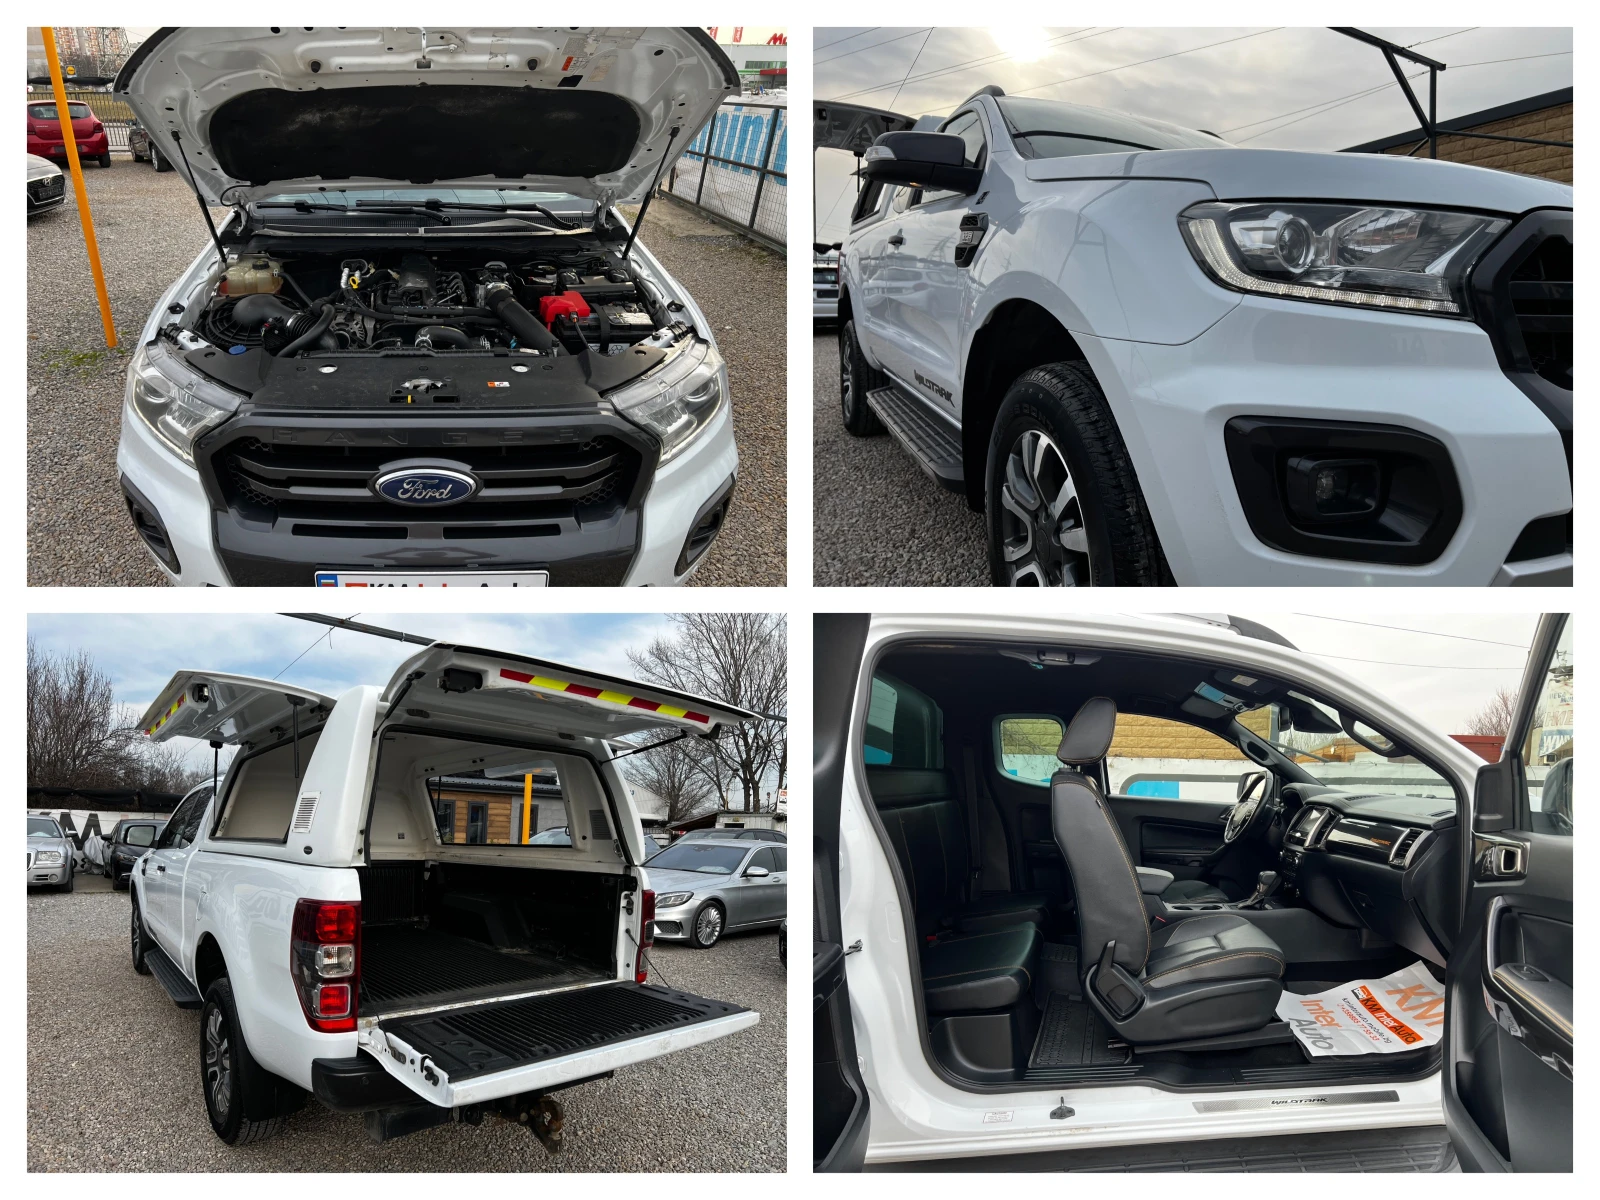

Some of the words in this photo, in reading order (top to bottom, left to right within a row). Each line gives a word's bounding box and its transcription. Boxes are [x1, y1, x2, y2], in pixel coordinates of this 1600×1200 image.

[272, 428, 580, 445] RANGER
[397, 478, 453, 499] Ford
[1299, 999, 1343, 1028] Inter
[1361, 997, 1382, 1013] KM
[1288, 1017, 1334, 1050] Auto
